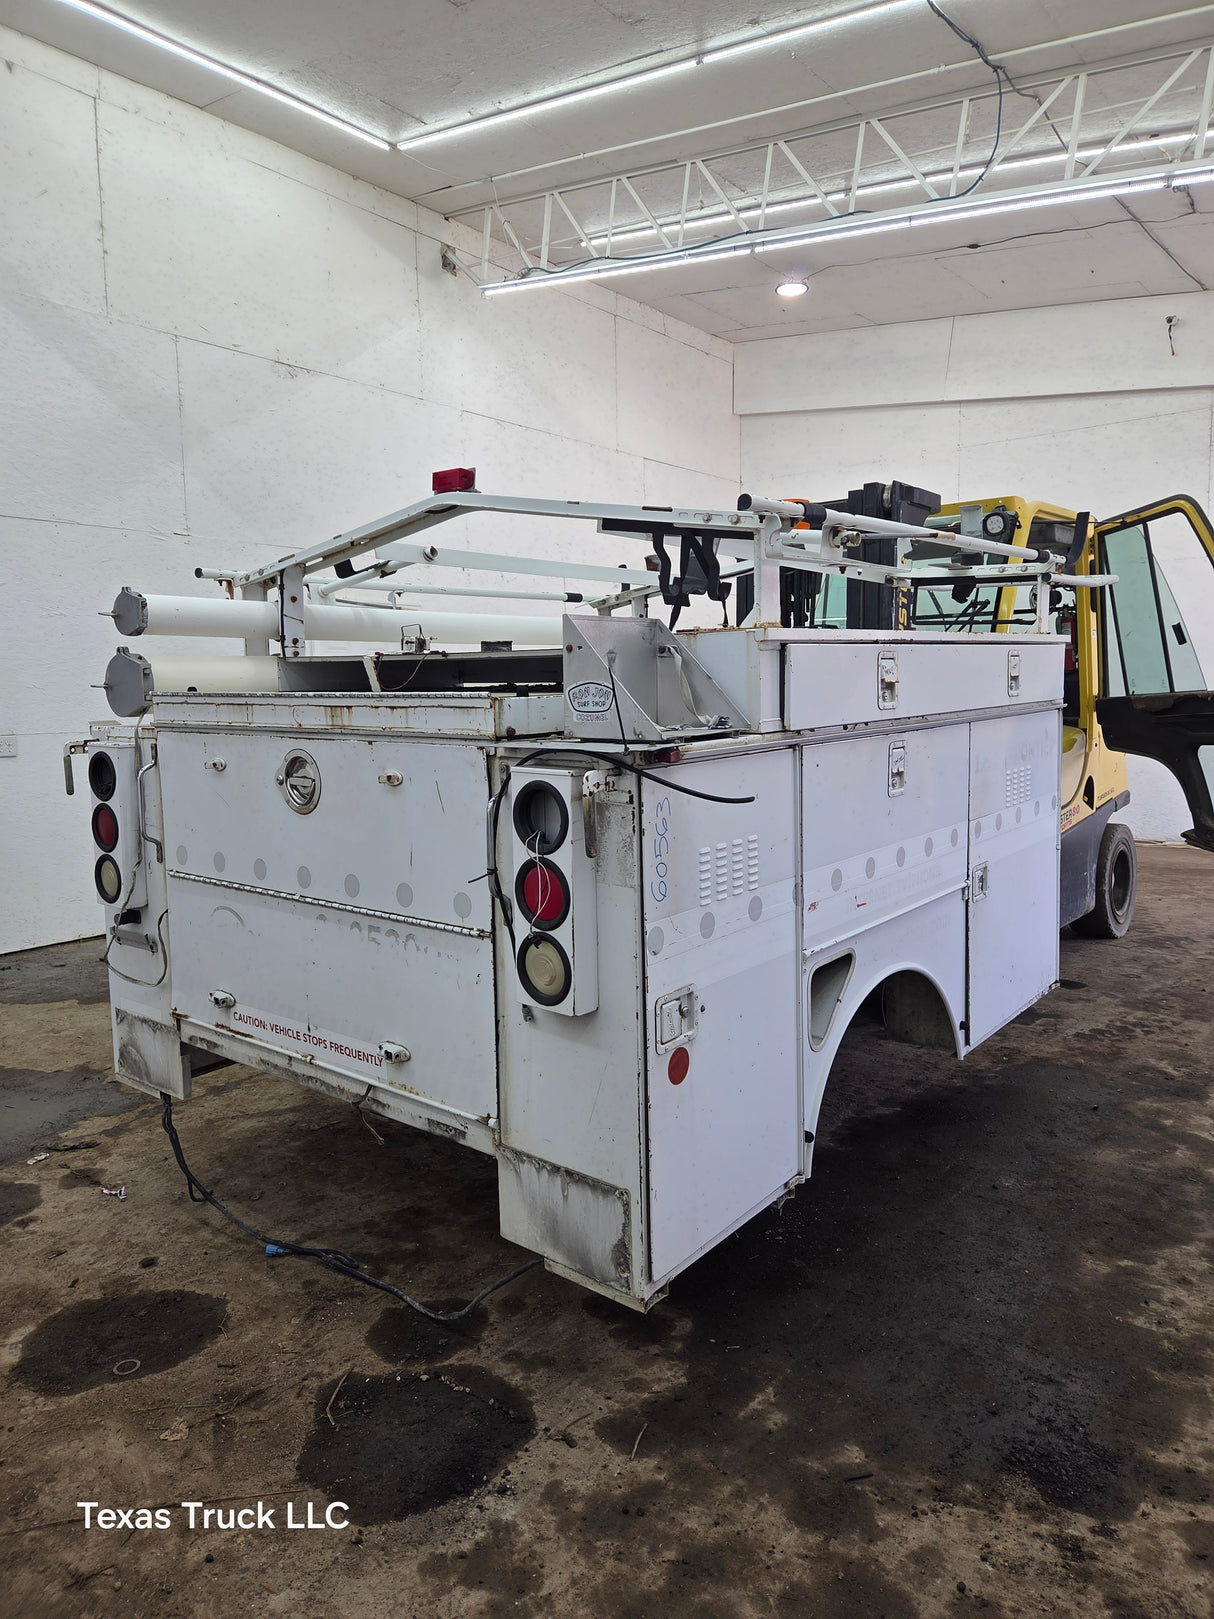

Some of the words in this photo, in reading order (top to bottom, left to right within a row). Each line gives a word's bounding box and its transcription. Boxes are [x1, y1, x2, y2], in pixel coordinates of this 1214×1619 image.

[577, 700, 590, 708] SURF
[591, 700, 606, 708] SHOP
[592, 686, 612, 701] JON
[651, 796, 672, 902] 60563
[233, 1011, 268, 1031] CAUTION:
[269, 1022, 301, 1041] VEHICLE
[302, 1032, 328, 1050] STOPS
[329, 1041, 384, 1068] FREQUENTLY
